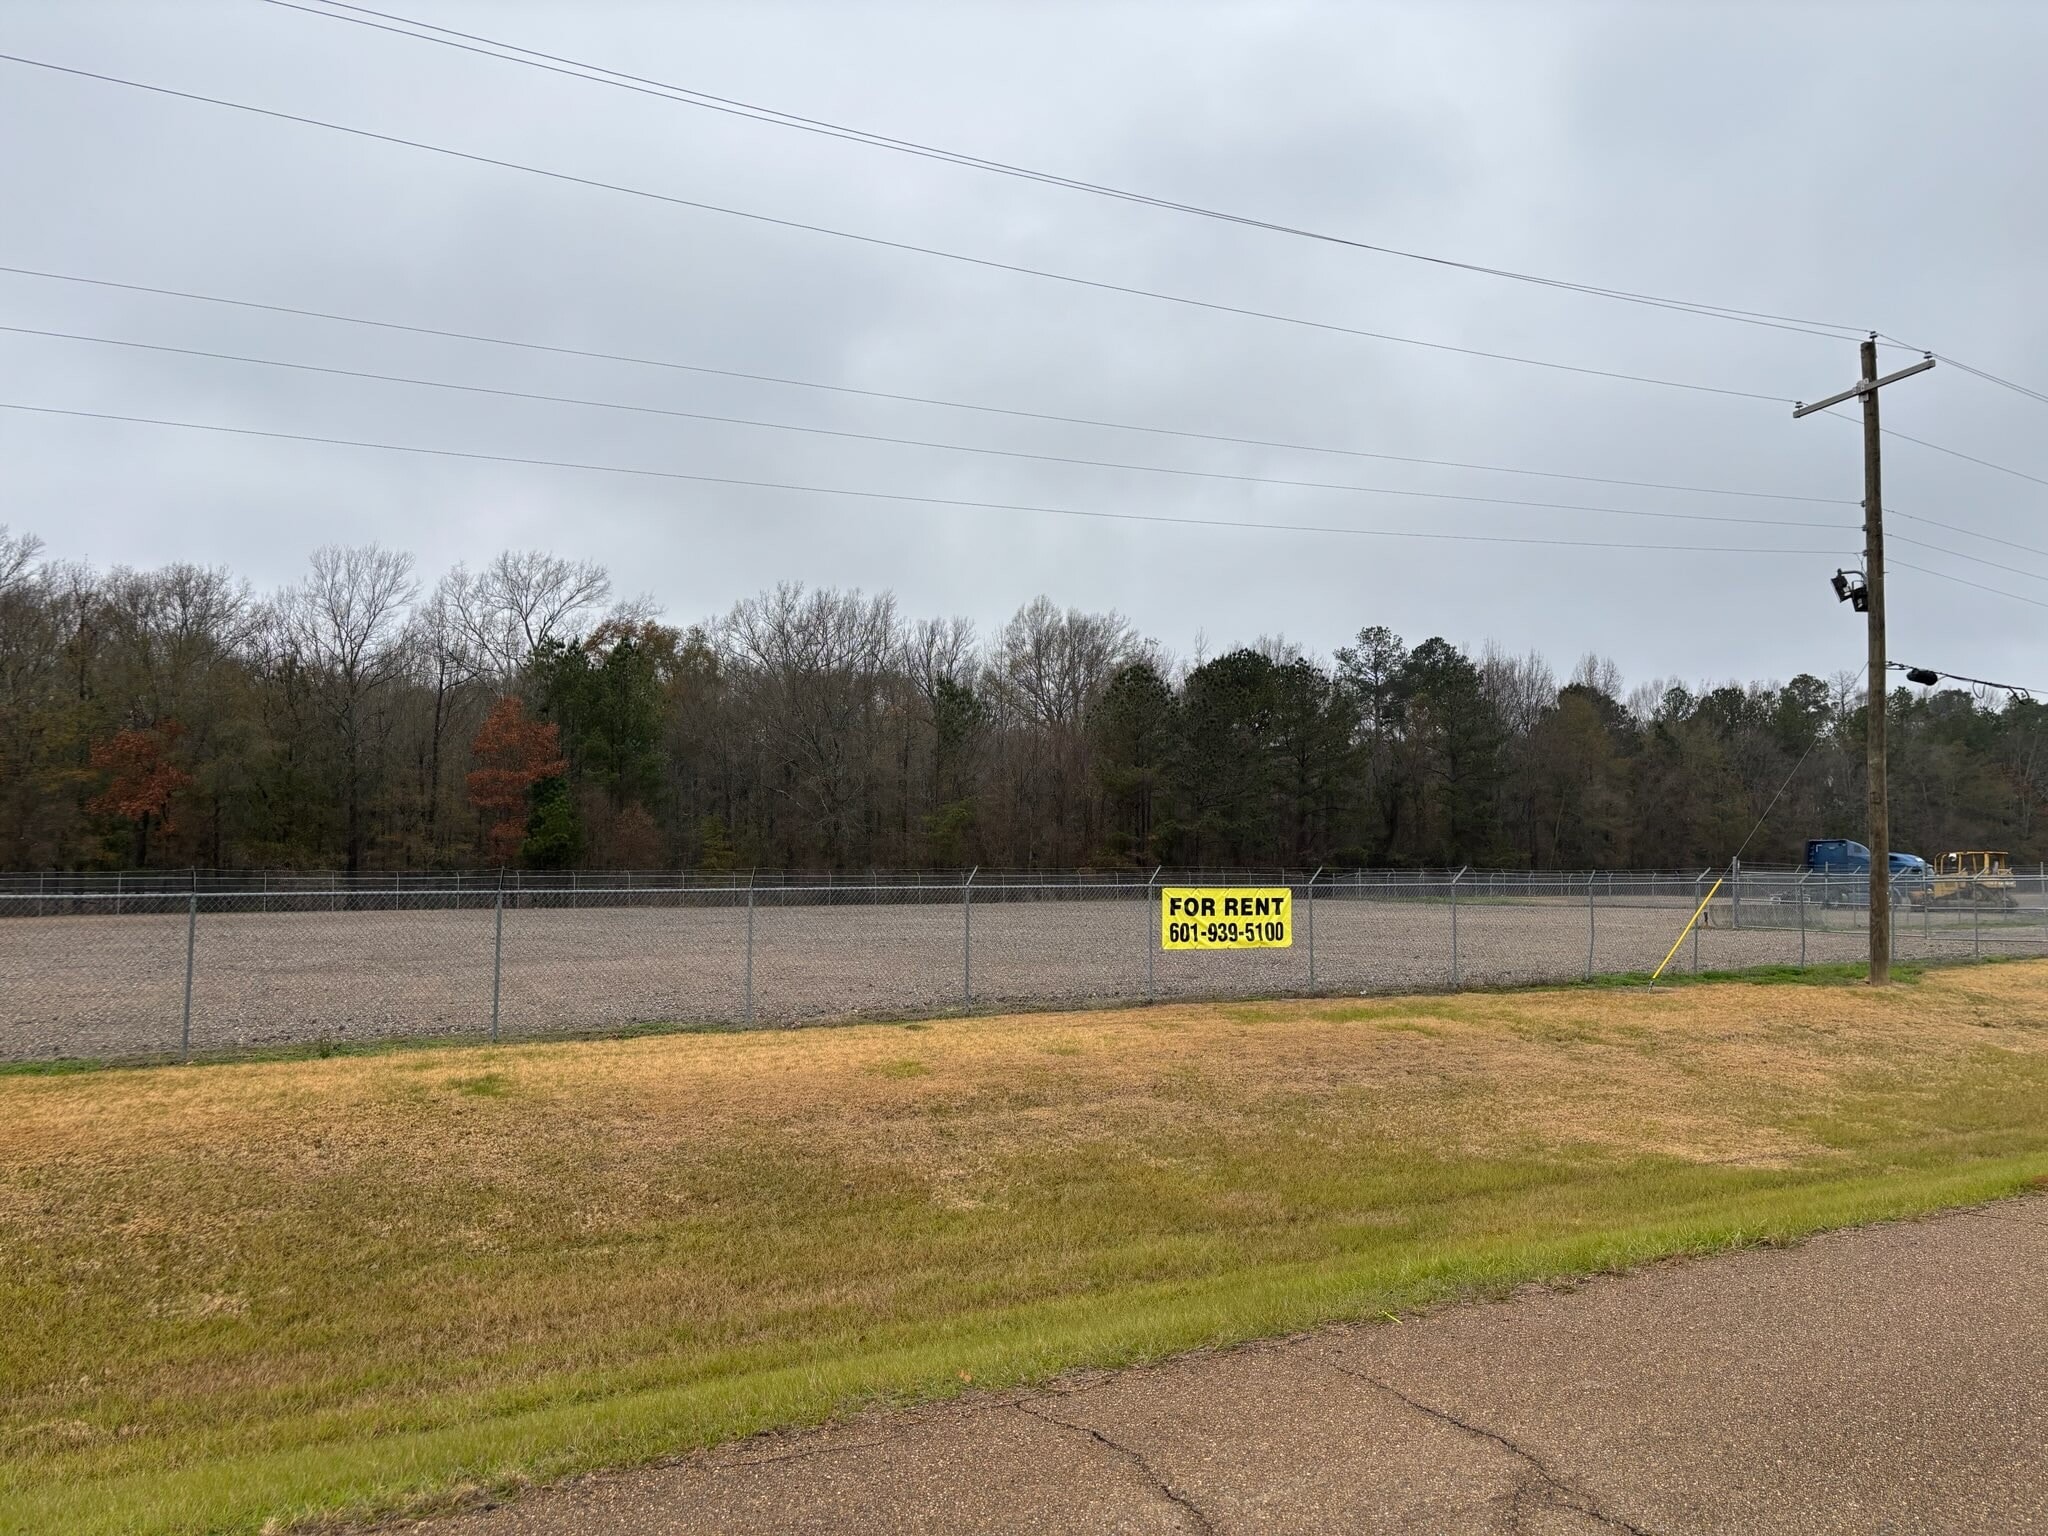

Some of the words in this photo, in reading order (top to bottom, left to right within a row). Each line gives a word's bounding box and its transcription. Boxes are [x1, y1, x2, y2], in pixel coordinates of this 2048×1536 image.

[1170, 897, 1215, 916] FOR
[1224, 897, 1284, 916] RENT
[1169, 922, 1284, 942] 601-939-5100
